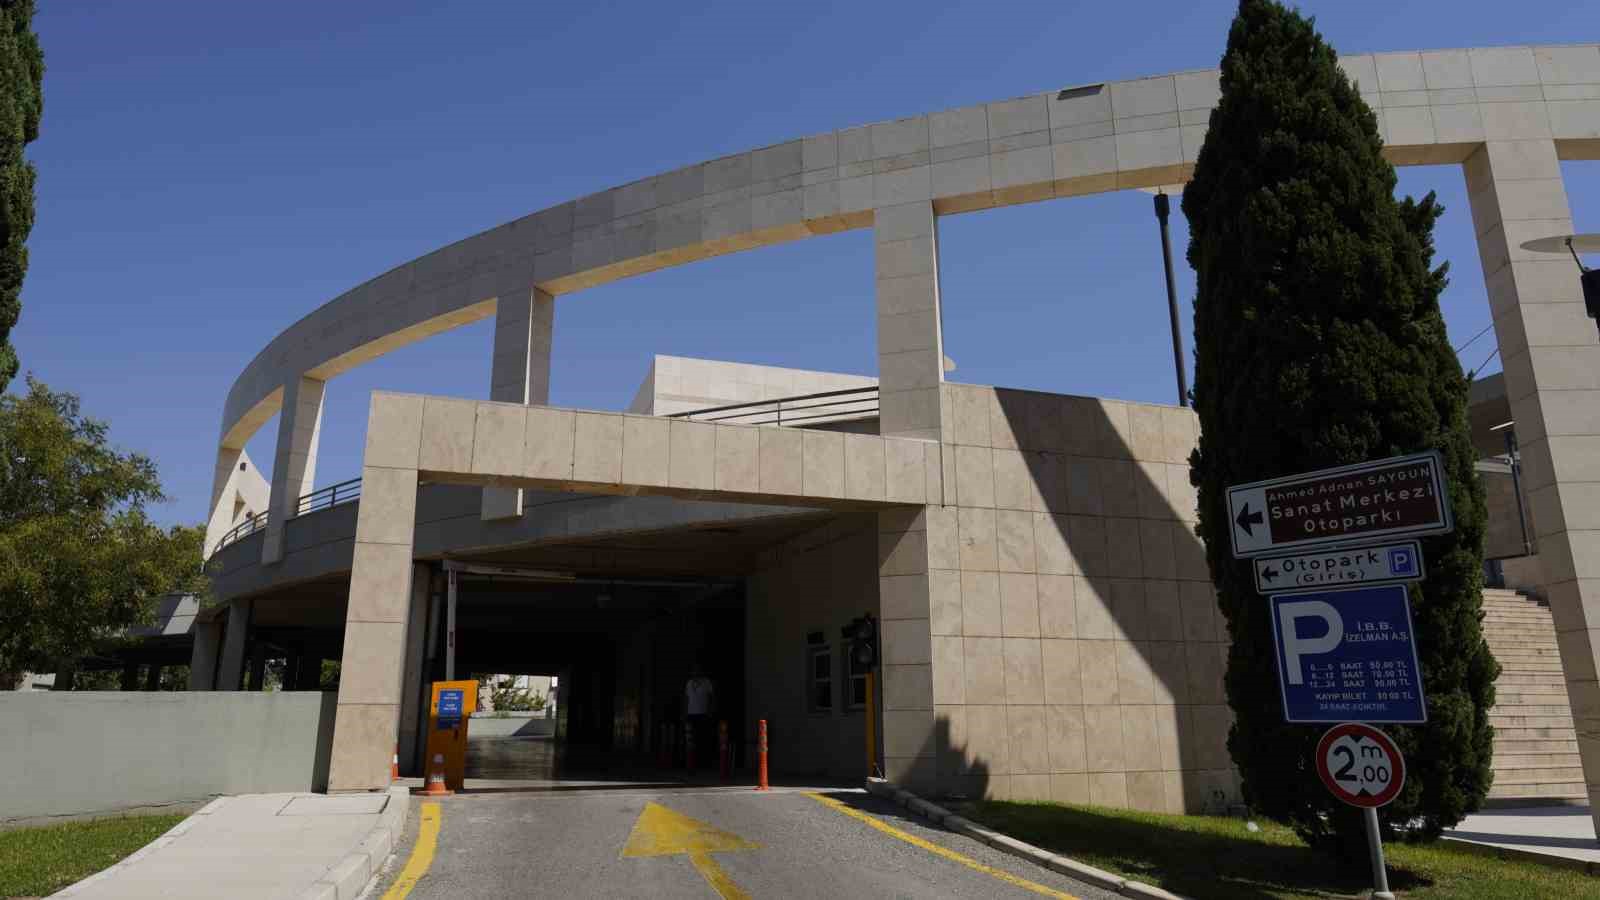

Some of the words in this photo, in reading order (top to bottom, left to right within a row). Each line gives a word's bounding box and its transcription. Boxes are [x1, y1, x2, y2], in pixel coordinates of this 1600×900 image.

[1269, 488, 1314, 502] Ahmed
[1320, 480, 1364, 495] Adnan
[1368, 467, 1430, 486] SAYGUN
[1271, 499, 1333, 519] Sanat
[1340, 483, 1433, 509] Merkezi
[1303, 509, 1401, 532] Otoparkı
[1282, 550, 1379, 572] Otopark
[1394, 552, 1408, 571] P
[1279, 600, 1344, 685] P
[1396, 660, 1408, 669] TL
[1397, 669, 1408, 677] TL
[1398, 678, 1410, 686] TL
[1401, 691, 1415, 700] TL
[1360, 745, 1382, 758] m
